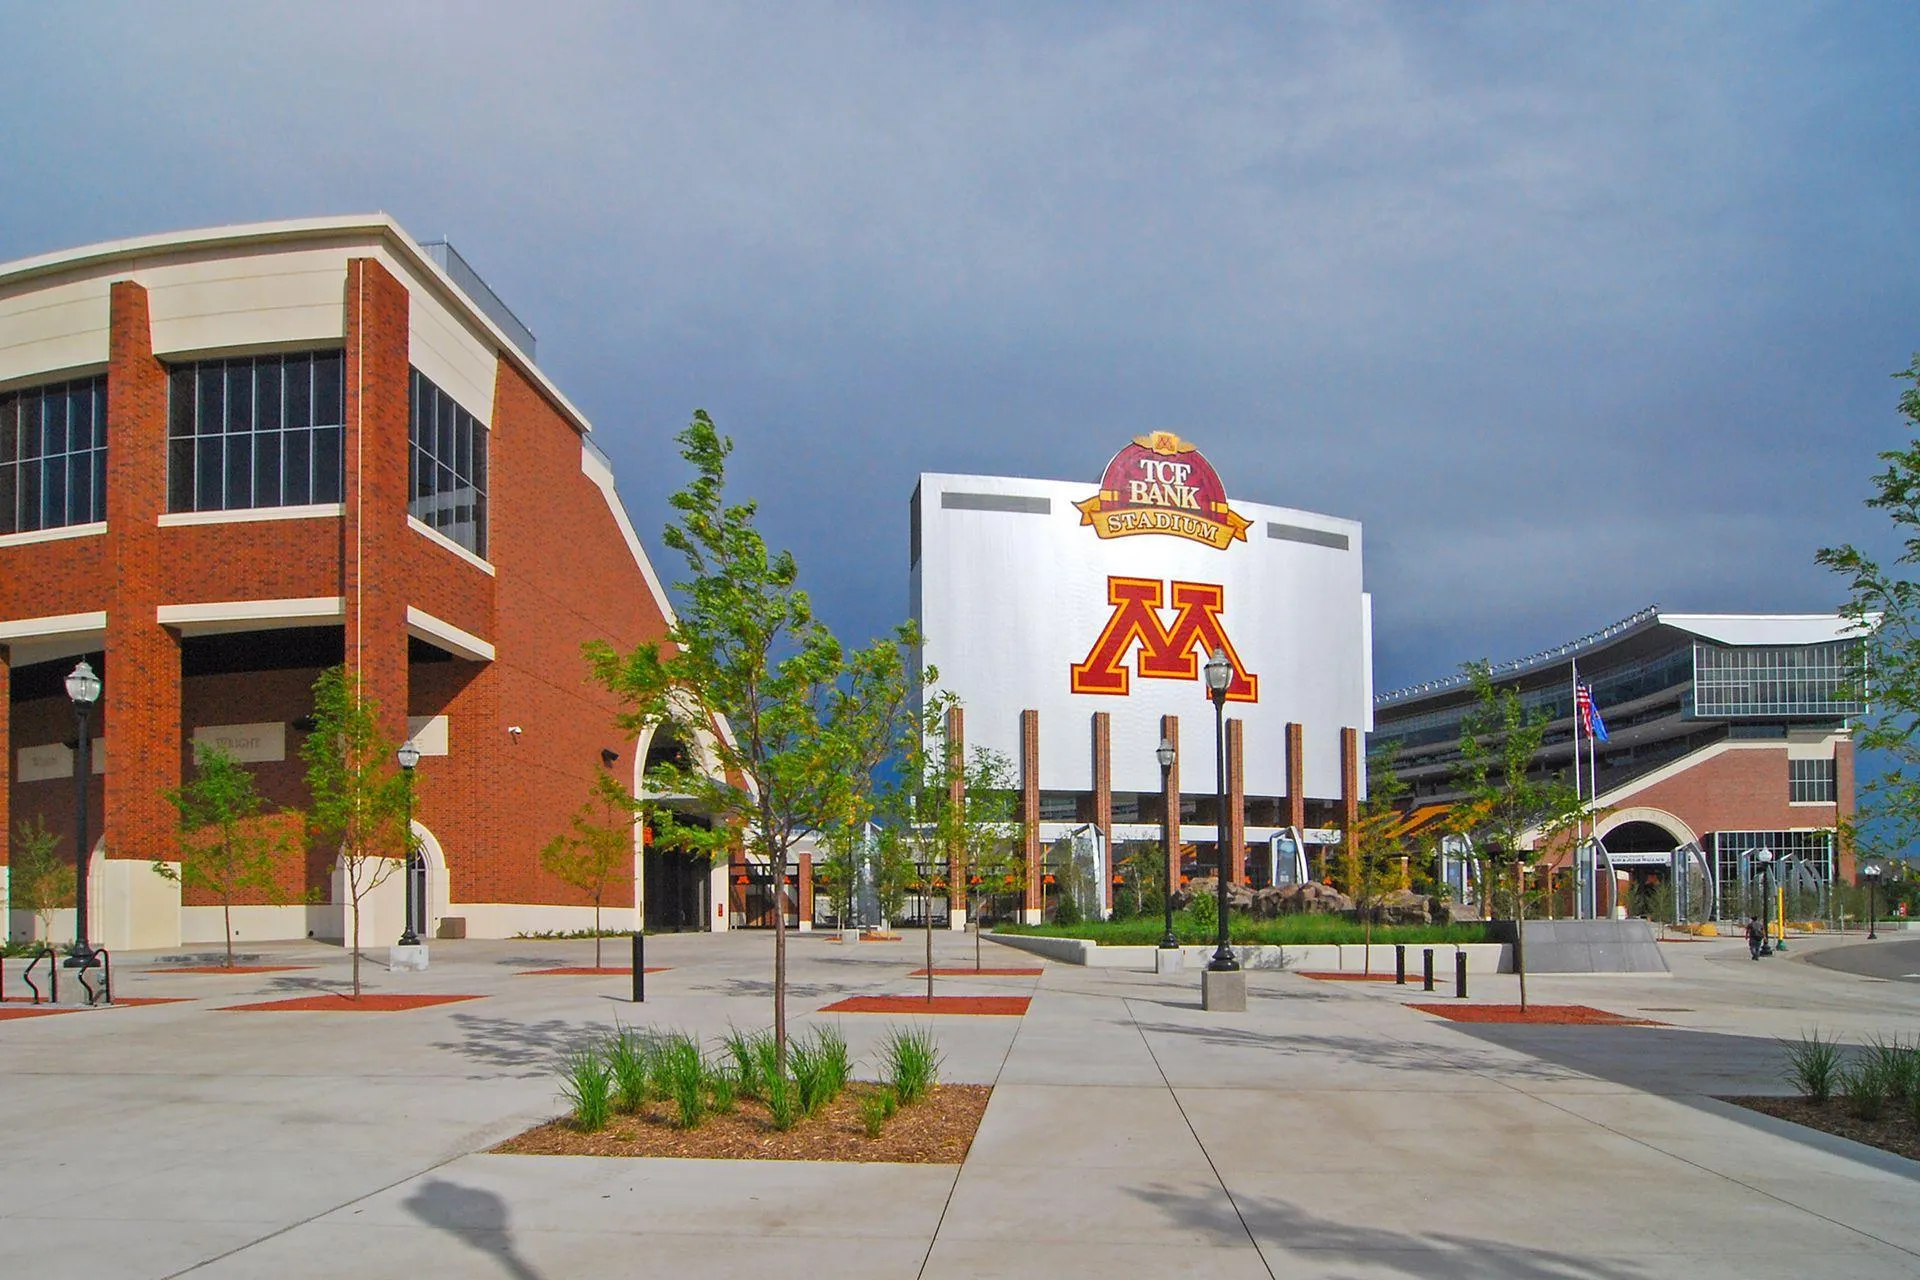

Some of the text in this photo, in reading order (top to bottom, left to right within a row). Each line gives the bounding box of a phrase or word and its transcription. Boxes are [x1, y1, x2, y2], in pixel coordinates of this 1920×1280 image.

[1140, 459, 1191, 486] TCF
[1128, 480, 1200, 510] BANK
[1107, 512, 1218, 541] STADIUM
[1070, 575, 1258, 703] M
